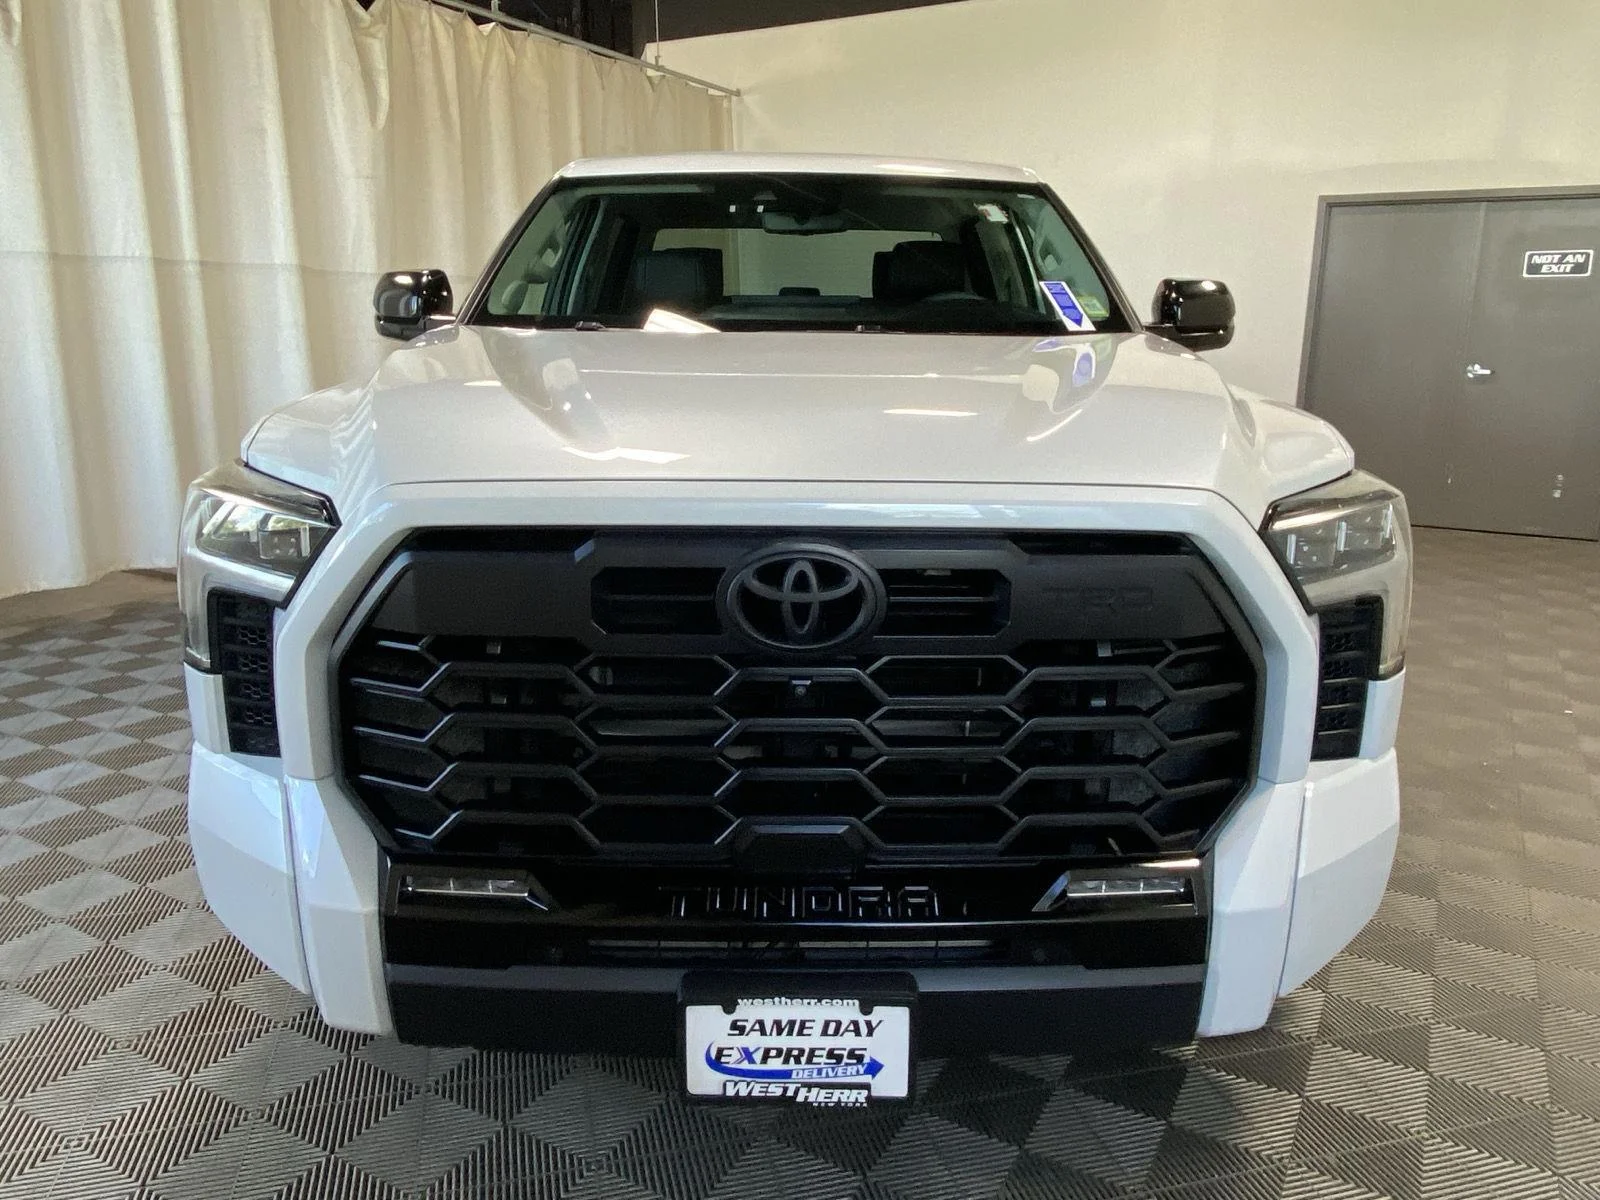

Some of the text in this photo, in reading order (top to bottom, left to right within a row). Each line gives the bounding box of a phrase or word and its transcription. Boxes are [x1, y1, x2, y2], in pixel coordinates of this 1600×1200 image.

[1531, 254, 1586, 264] NOT AN
[1540, 264, 1574, 273] EXIT
[657, 886, 938, 918] TUNDRA
[737, 996, 859, 1007] westherr.com
[727, 1019, 883, 1037] SAME DAY
[714, 1046, 867, 1065] EXPRESS
[791, 1064, 867, 1079] DELIVERY
